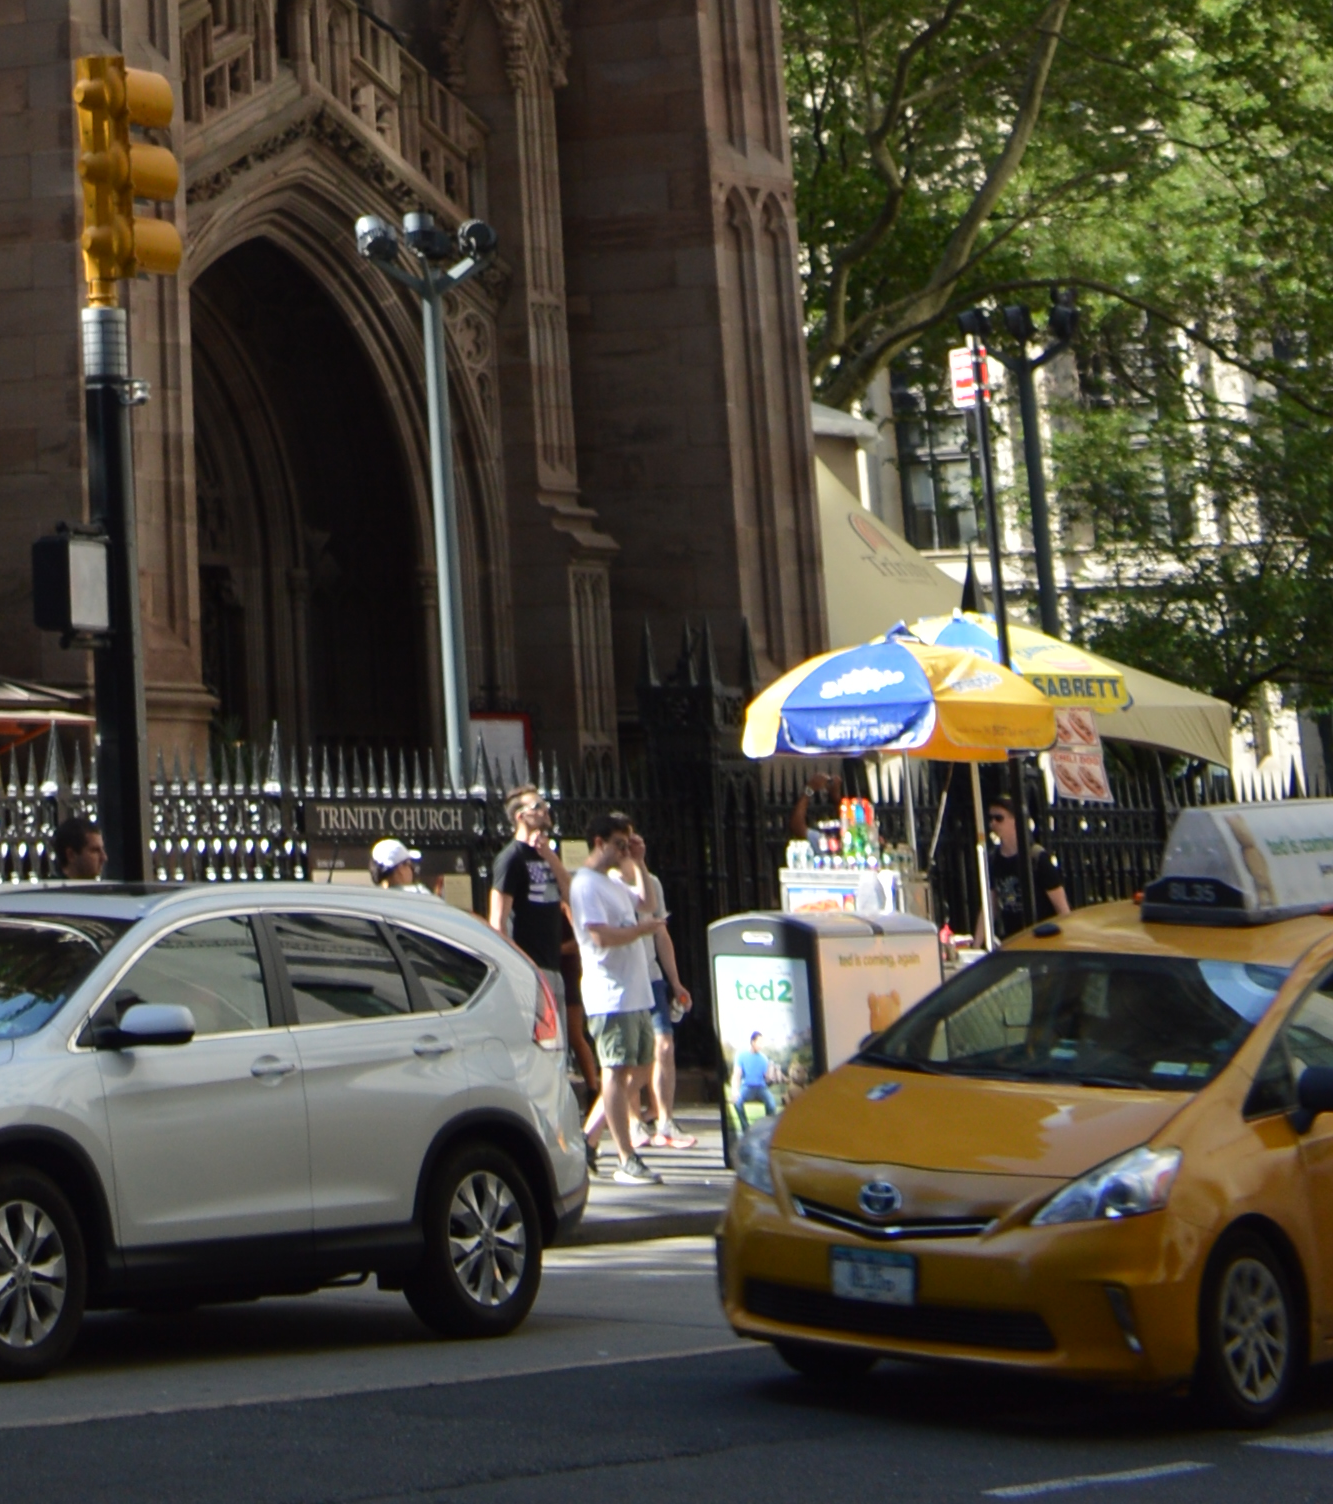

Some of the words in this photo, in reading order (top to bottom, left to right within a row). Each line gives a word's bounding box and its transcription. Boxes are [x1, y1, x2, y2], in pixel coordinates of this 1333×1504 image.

[1033, 677, 1120, 699] SABRETT
[315, 805, 386, 830] TRINITY
[390, 806, 463, 831] CHURCH
[838, 953, 853, 967] ted
[855, 954, 862, 967] is
[863, 953, 897, 968] coming,
[897, 953, 921, 968] again
